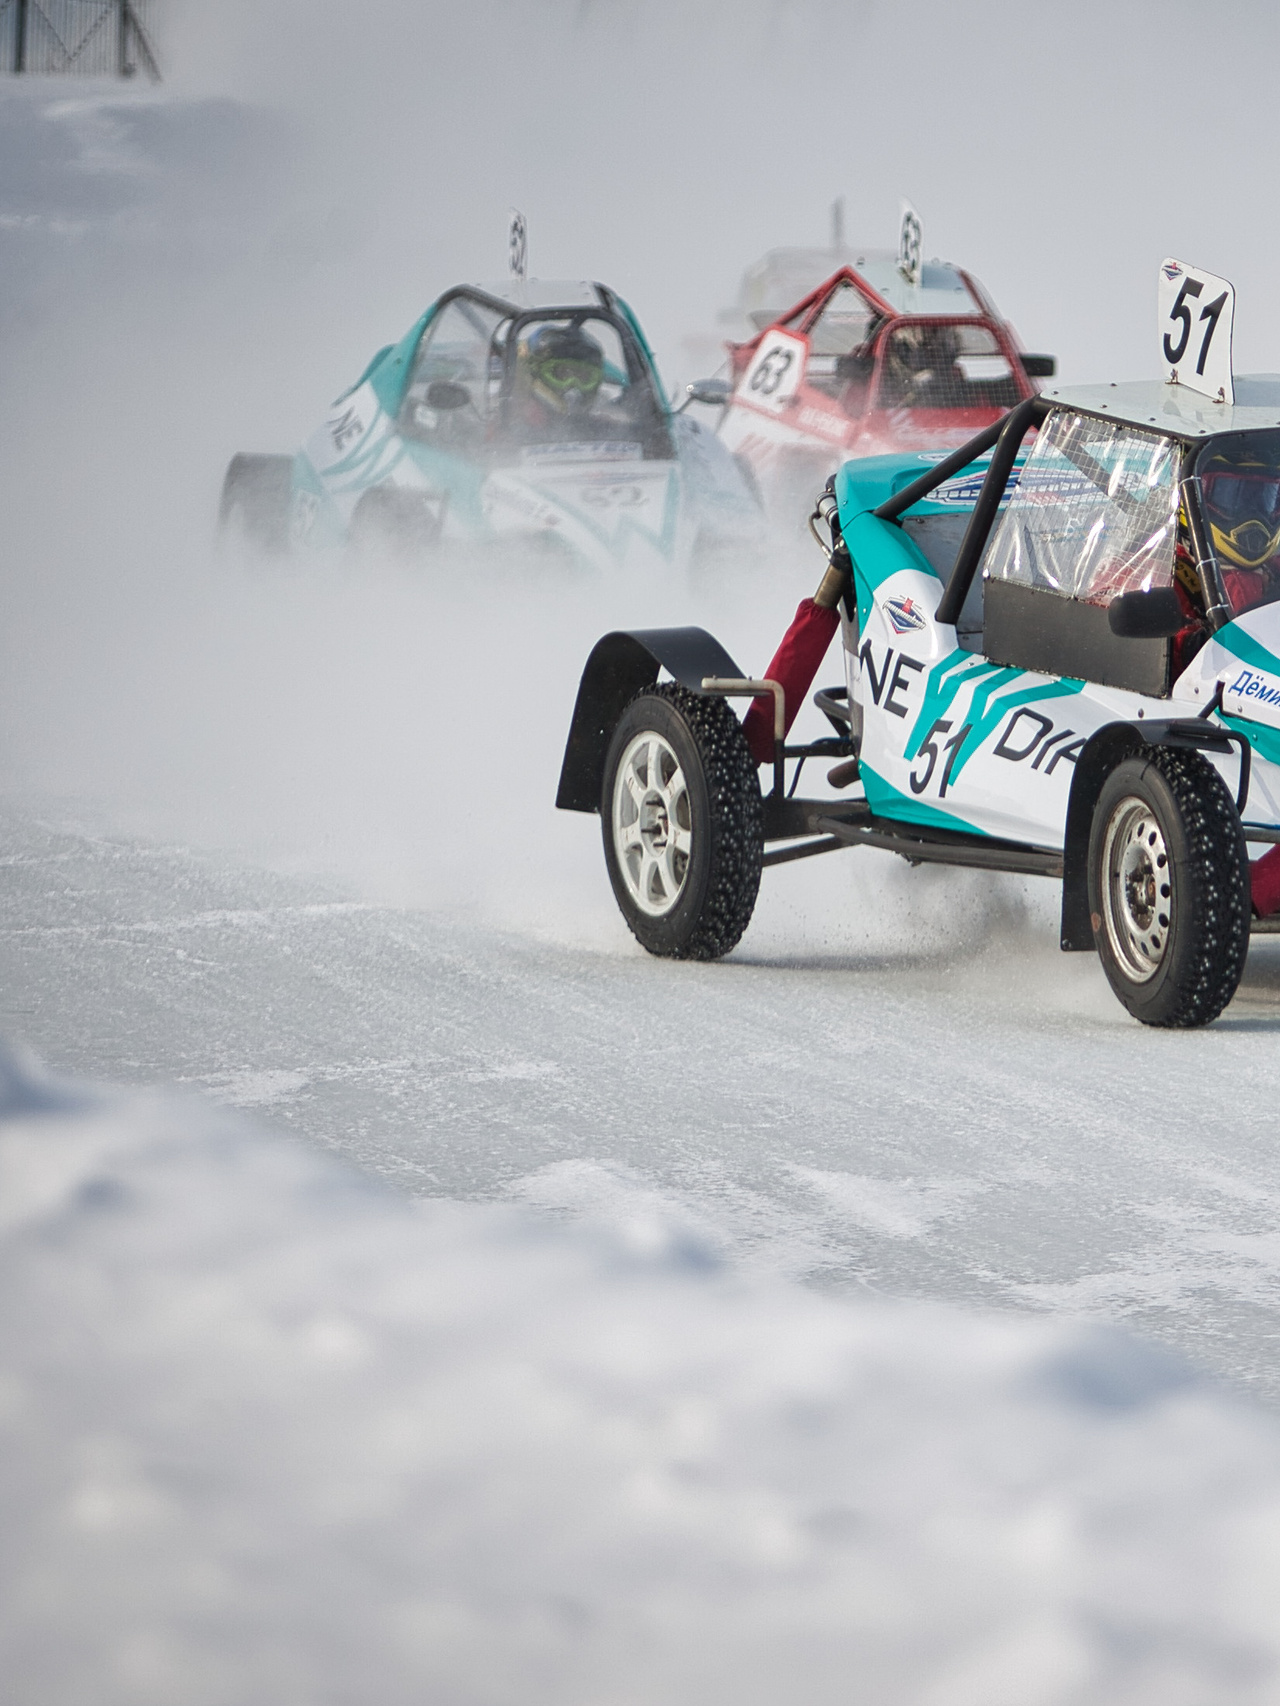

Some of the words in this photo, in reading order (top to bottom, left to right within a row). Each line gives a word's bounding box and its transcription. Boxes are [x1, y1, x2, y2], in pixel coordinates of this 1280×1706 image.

[1163, 276, 1229, 376] 51
[751, 345, 794, 395] 63
[910, 718, 973, 798] 51
